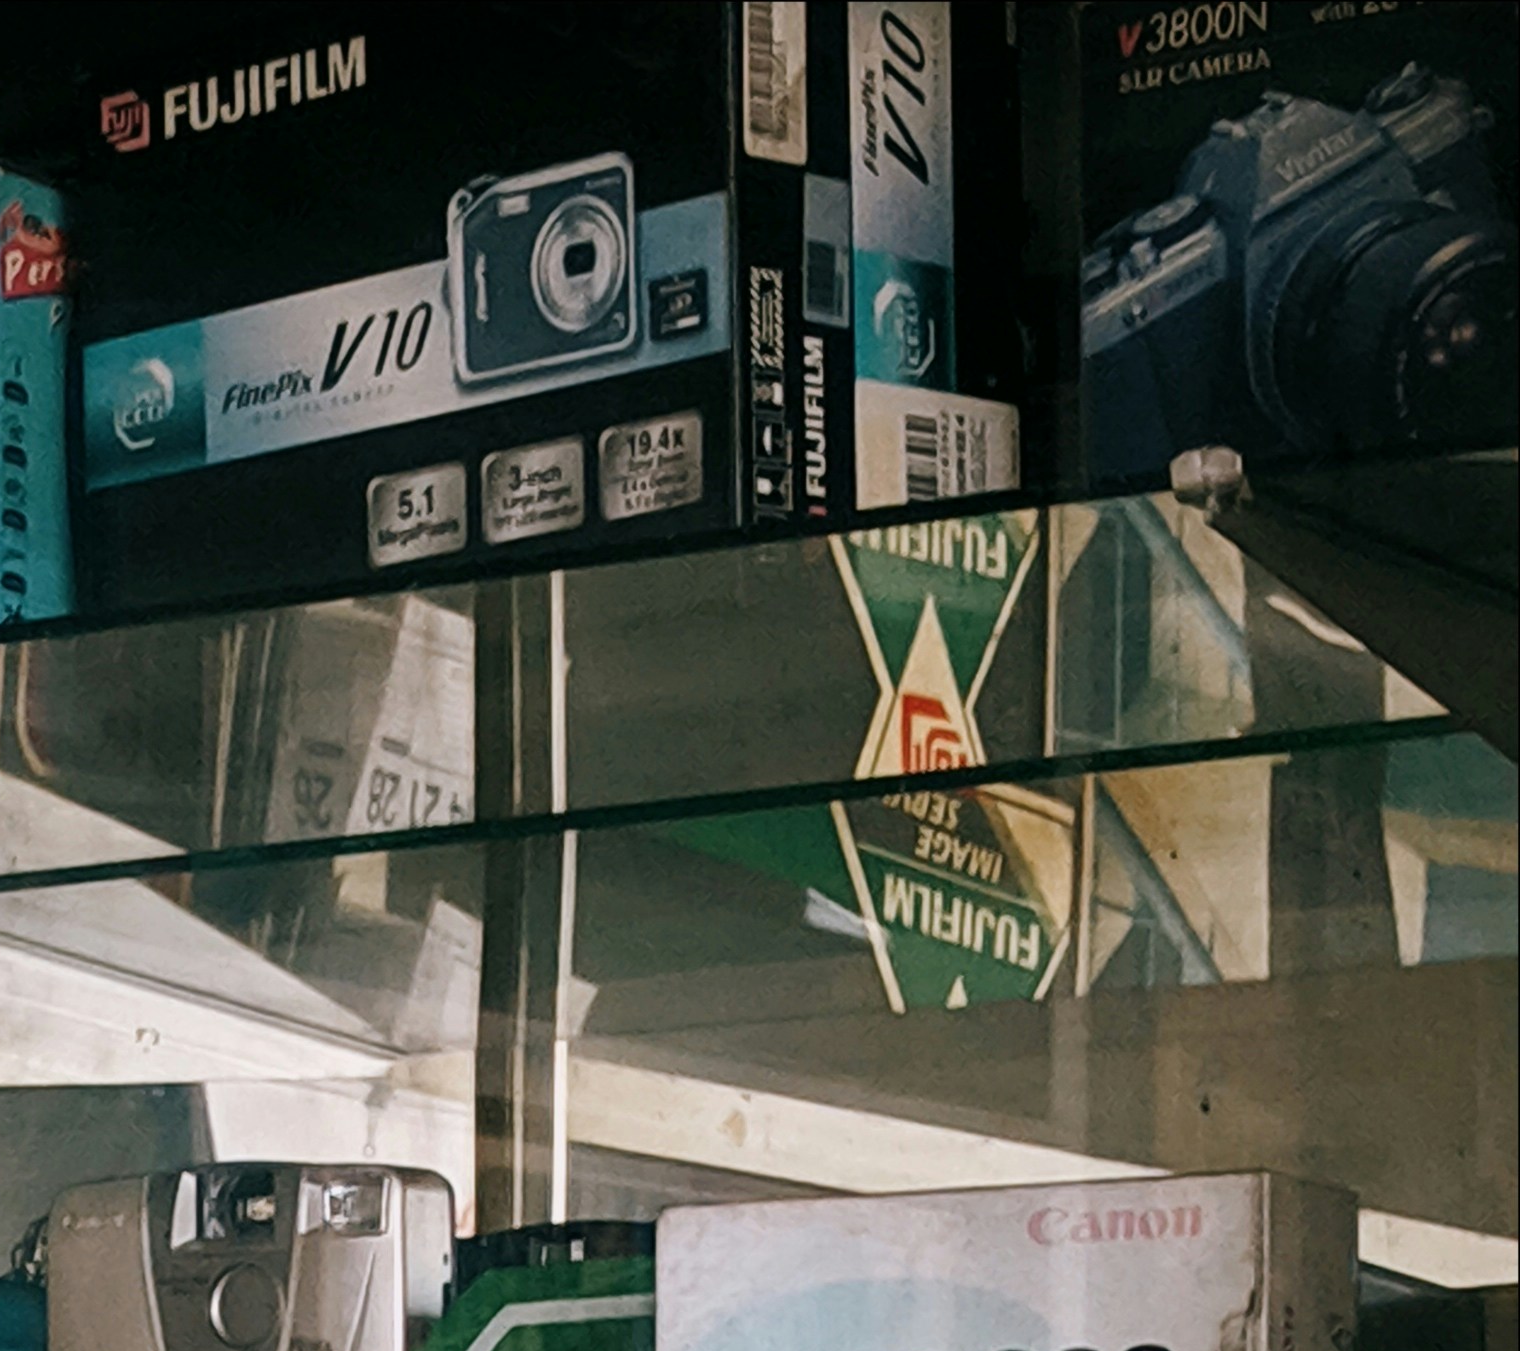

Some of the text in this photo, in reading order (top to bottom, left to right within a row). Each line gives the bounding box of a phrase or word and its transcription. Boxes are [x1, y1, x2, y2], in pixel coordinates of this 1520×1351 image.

[164, 36, 367, 139] FUJIFILM
[1169, 47, 1271, 84] CAMERA
[320, 300, 433, 393] V10
[221, 369, 318, 415] FinePix
[804, 335, 828, 499] FUJIFILM
[397, 484, 437, 521] 5.1
[914, 829, 1004, 884] IMAGE
[882, 872, 1041, 971] FUJIFILM
[1027, 1204, 1203, 1246] Canon
